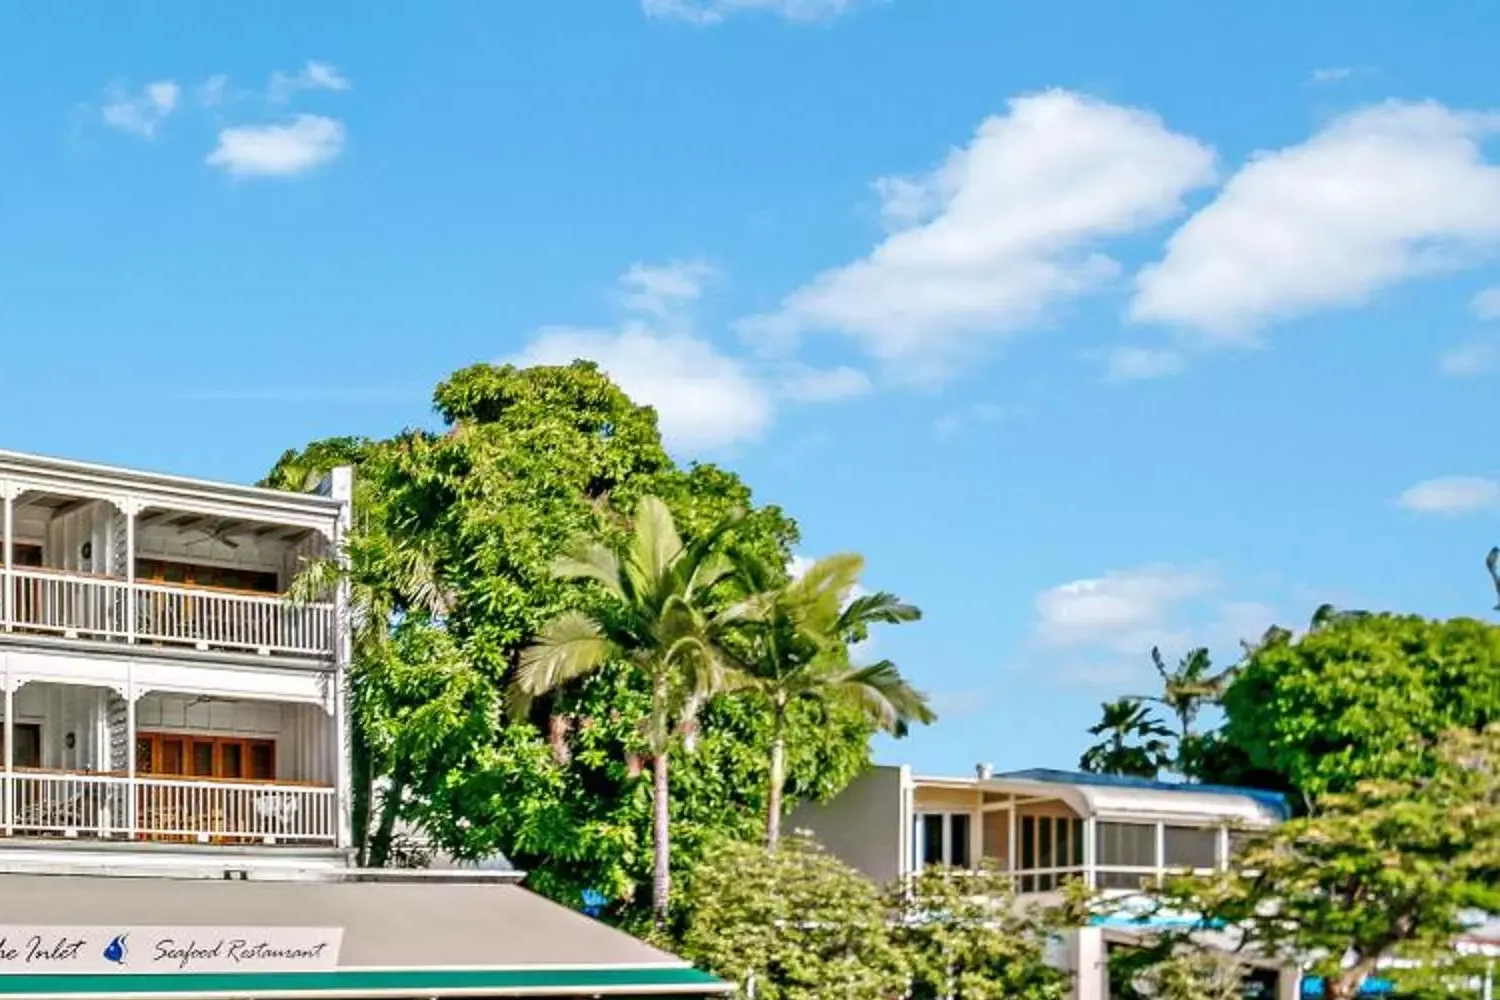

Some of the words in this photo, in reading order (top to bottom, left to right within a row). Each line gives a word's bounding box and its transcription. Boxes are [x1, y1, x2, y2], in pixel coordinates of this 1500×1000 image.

[25, 935, 87, 963] Inlet
[153, 939, 224, 969] Seafood
[227, 939, 328, 963] Restaurant
